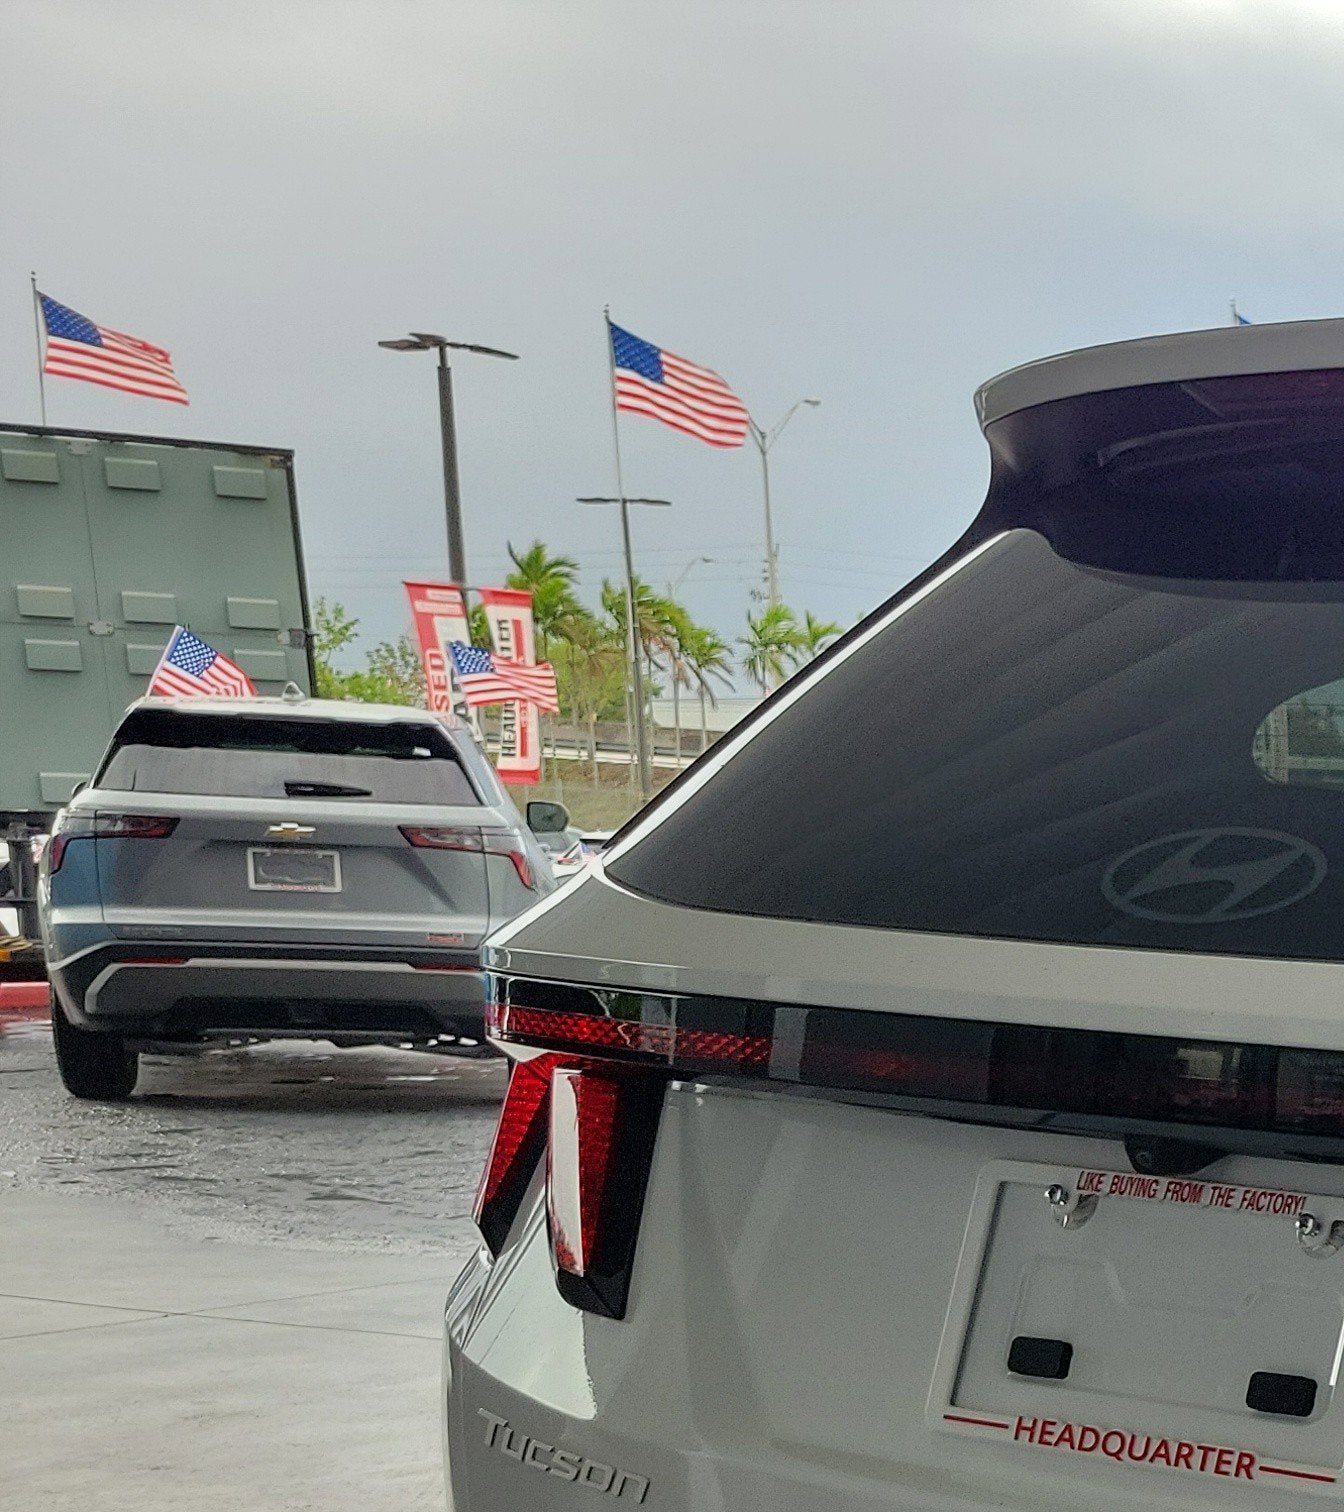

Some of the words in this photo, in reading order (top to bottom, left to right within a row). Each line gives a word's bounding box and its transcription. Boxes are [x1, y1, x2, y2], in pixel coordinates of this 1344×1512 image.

[1076, 1171, 1104, 1192] LIKE
[1109, 1175, 1159, 1198] BUYING
[1163, 1181, 1205, 1204] FROM
[1208, 1186, 1236, 1207] THE
[1239, 1190, 1307, 1216] FACTORY!
[1014, 1416, 1257, 1480] HEADQUARTER
